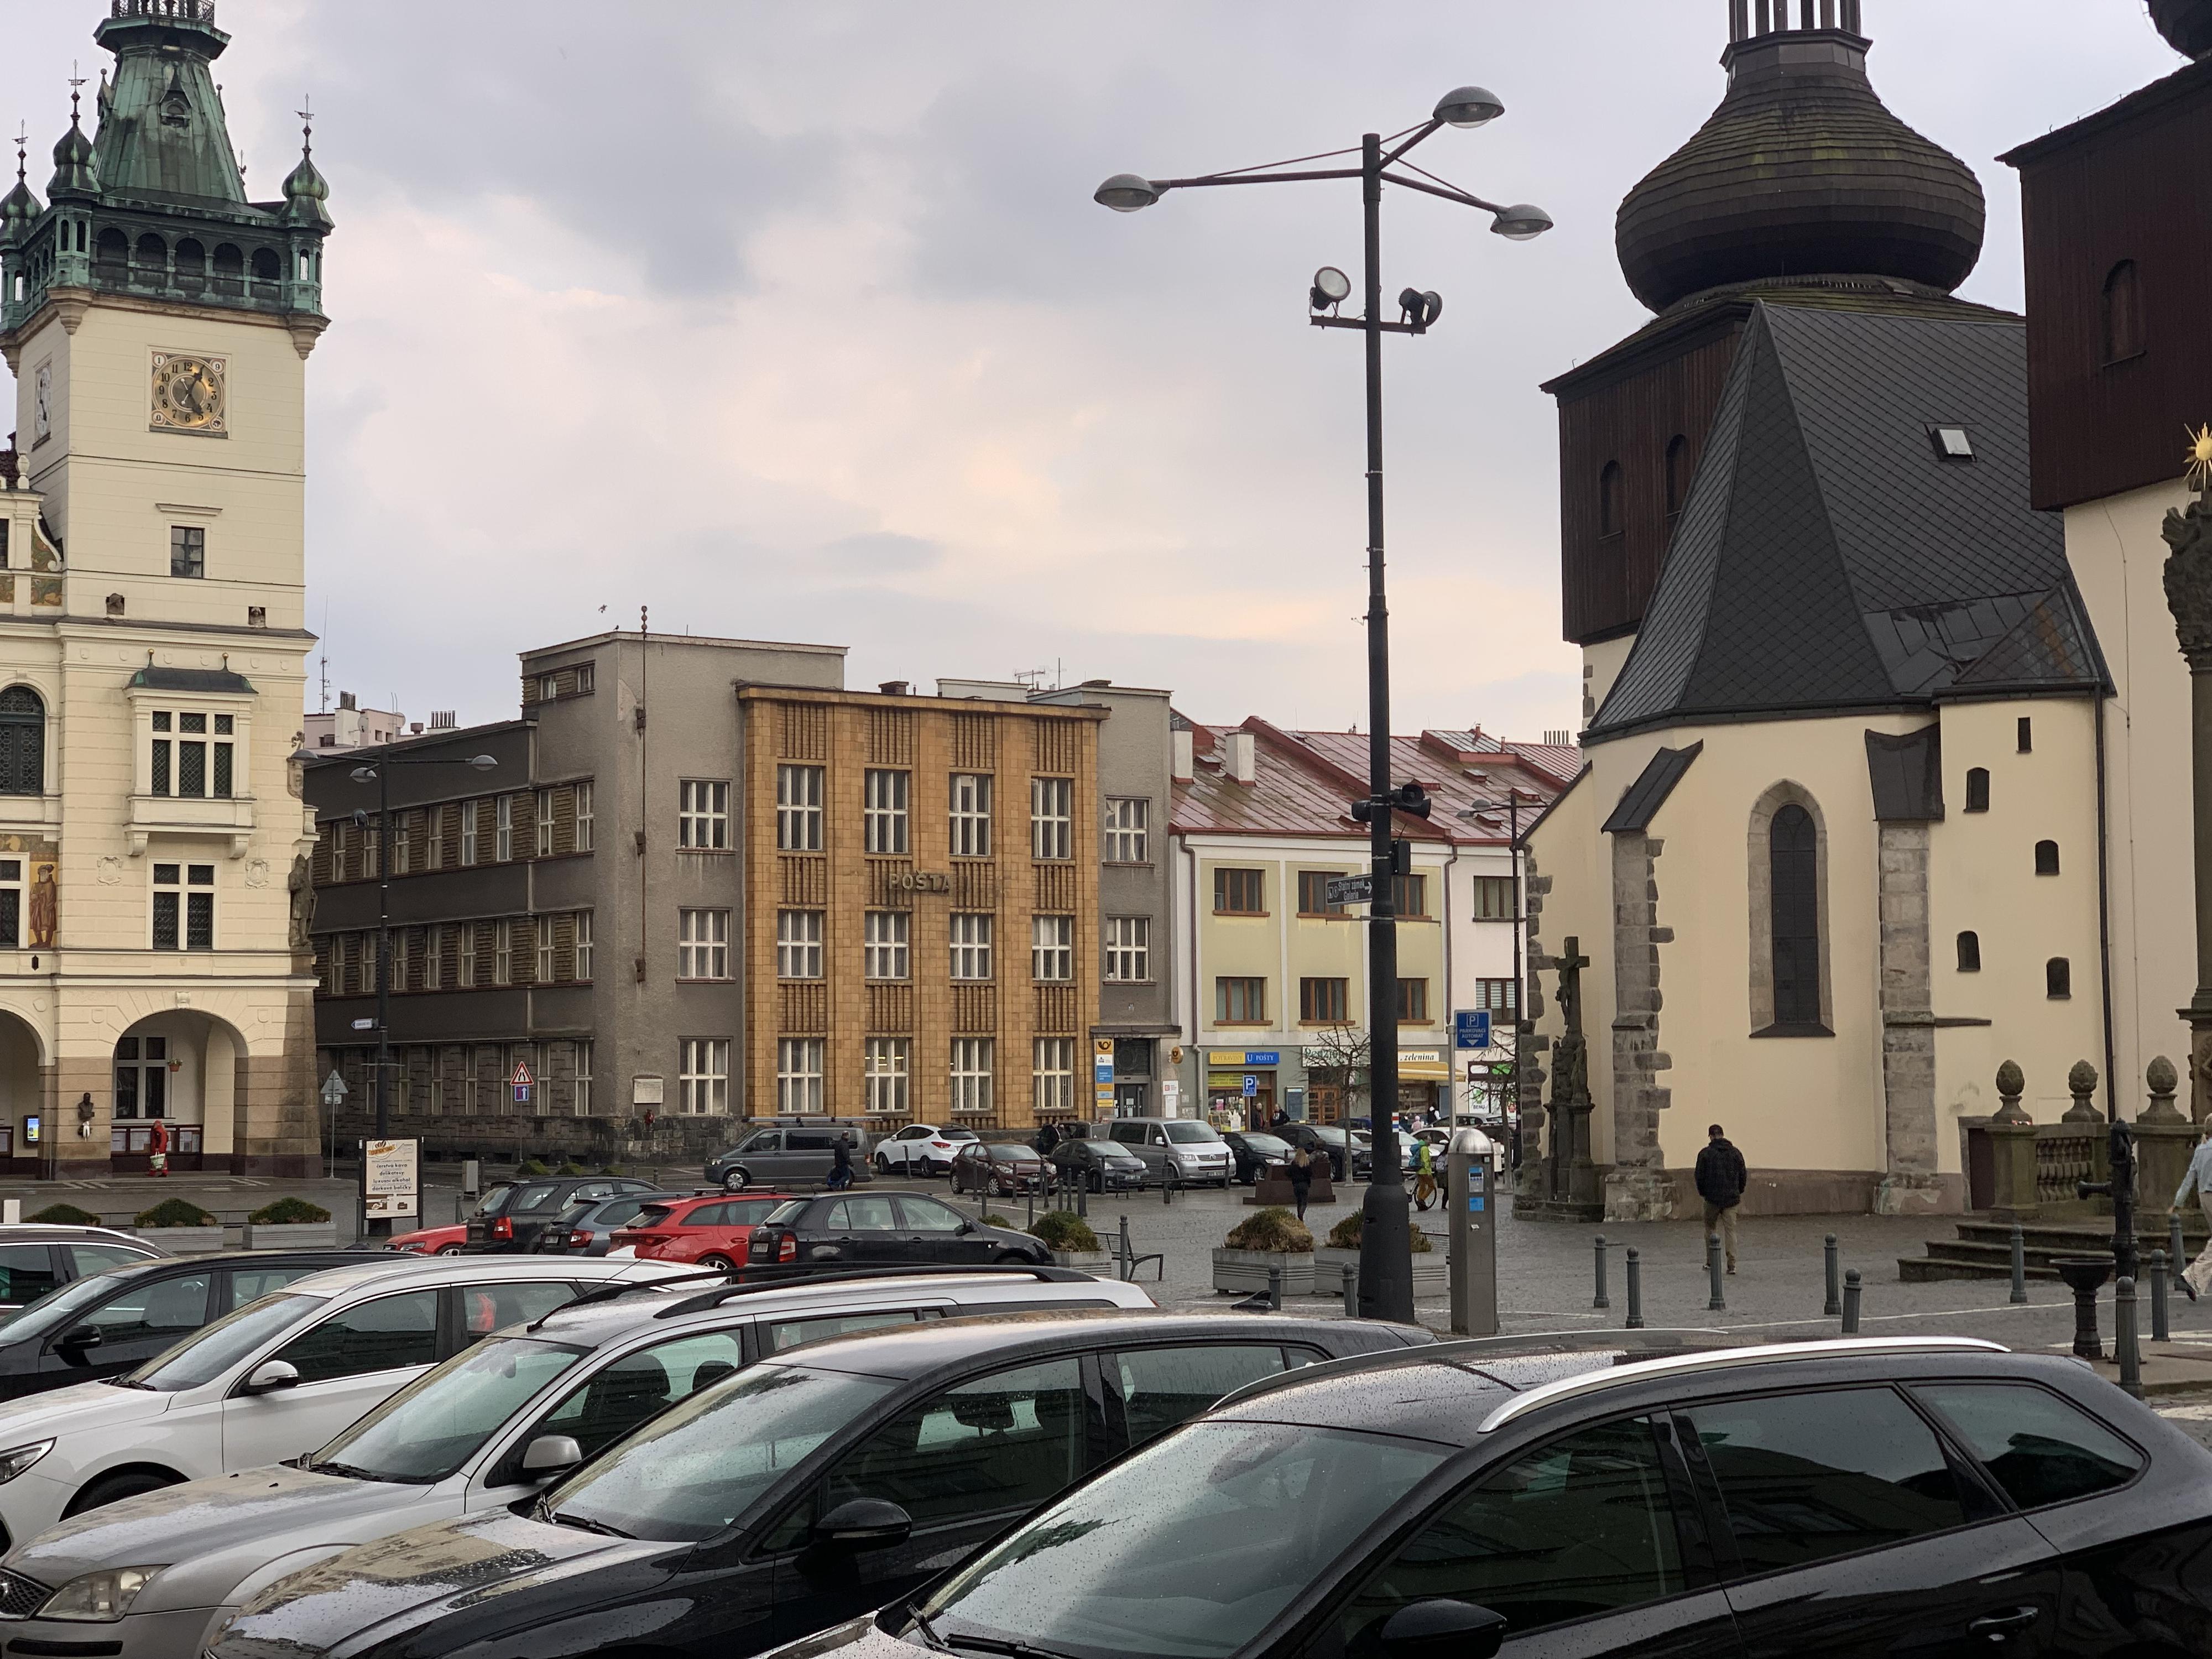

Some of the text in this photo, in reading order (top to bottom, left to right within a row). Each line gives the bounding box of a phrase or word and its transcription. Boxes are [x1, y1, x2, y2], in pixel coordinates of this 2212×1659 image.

[172, 364, 178, 373] 11
[183, 362, 192, 372] 12
[161, 373, 170, 382] 10
[208, 378, 213, 387] 2
[159, 385, 165, 394] 9
[211, 391, 217, 400] 3
[162, 399, 168, 408] 8
[207, 403, 213, 413] 4
[172, 409, 178, 418] 7
[185, 413, 191, 422] 6
[889, 870, 951, 891] POŠTA
[1469, 1016, 1476, 1025] P
[1245, 1078, 1254, 1090] P
